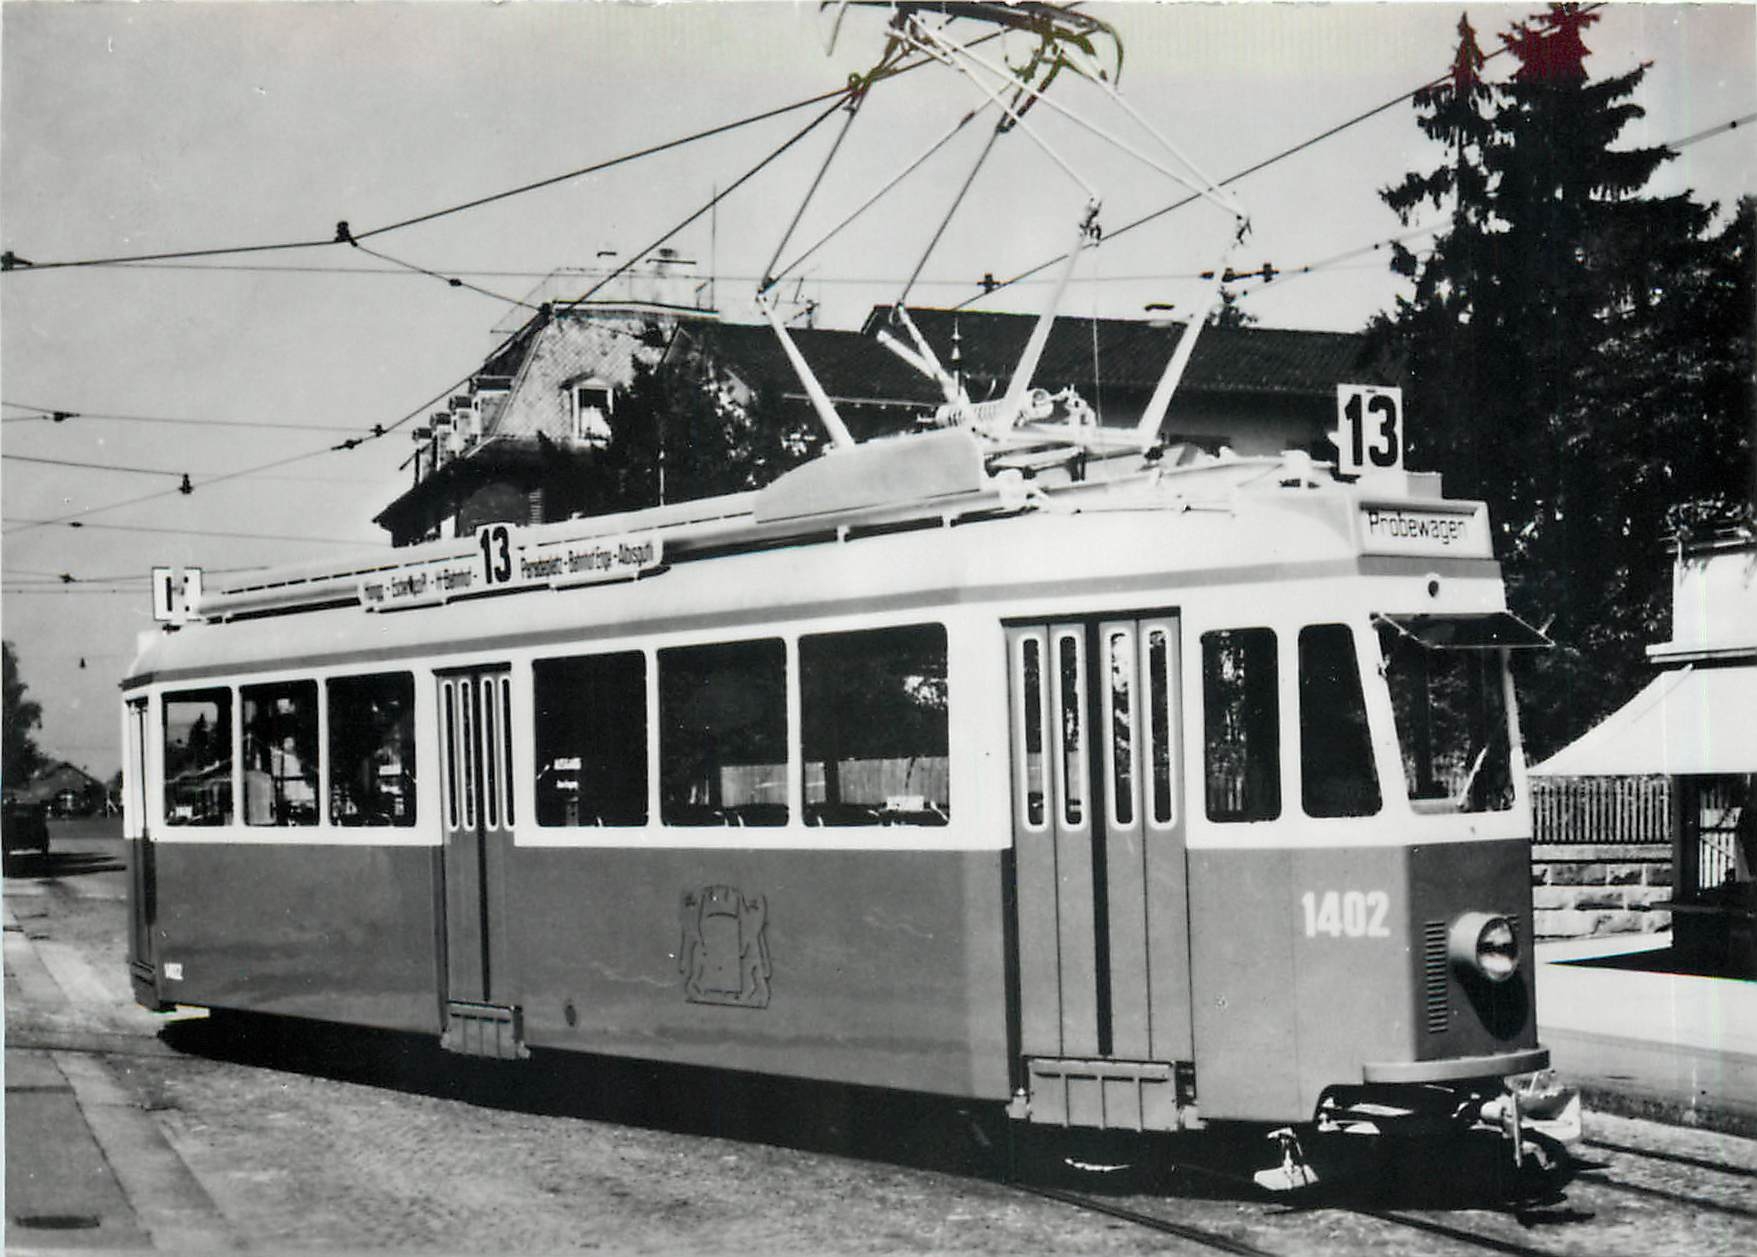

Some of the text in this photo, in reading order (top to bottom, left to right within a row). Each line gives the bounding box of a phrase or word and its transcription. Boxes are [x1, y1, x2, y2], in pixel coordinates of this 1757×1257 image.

[1344, 394, 1398, 467] 13
[1368, 511, 1466, 545] Probewagen
[480, 526, 512, 584] 13
[1302, 891, 1390, 937] 1402
